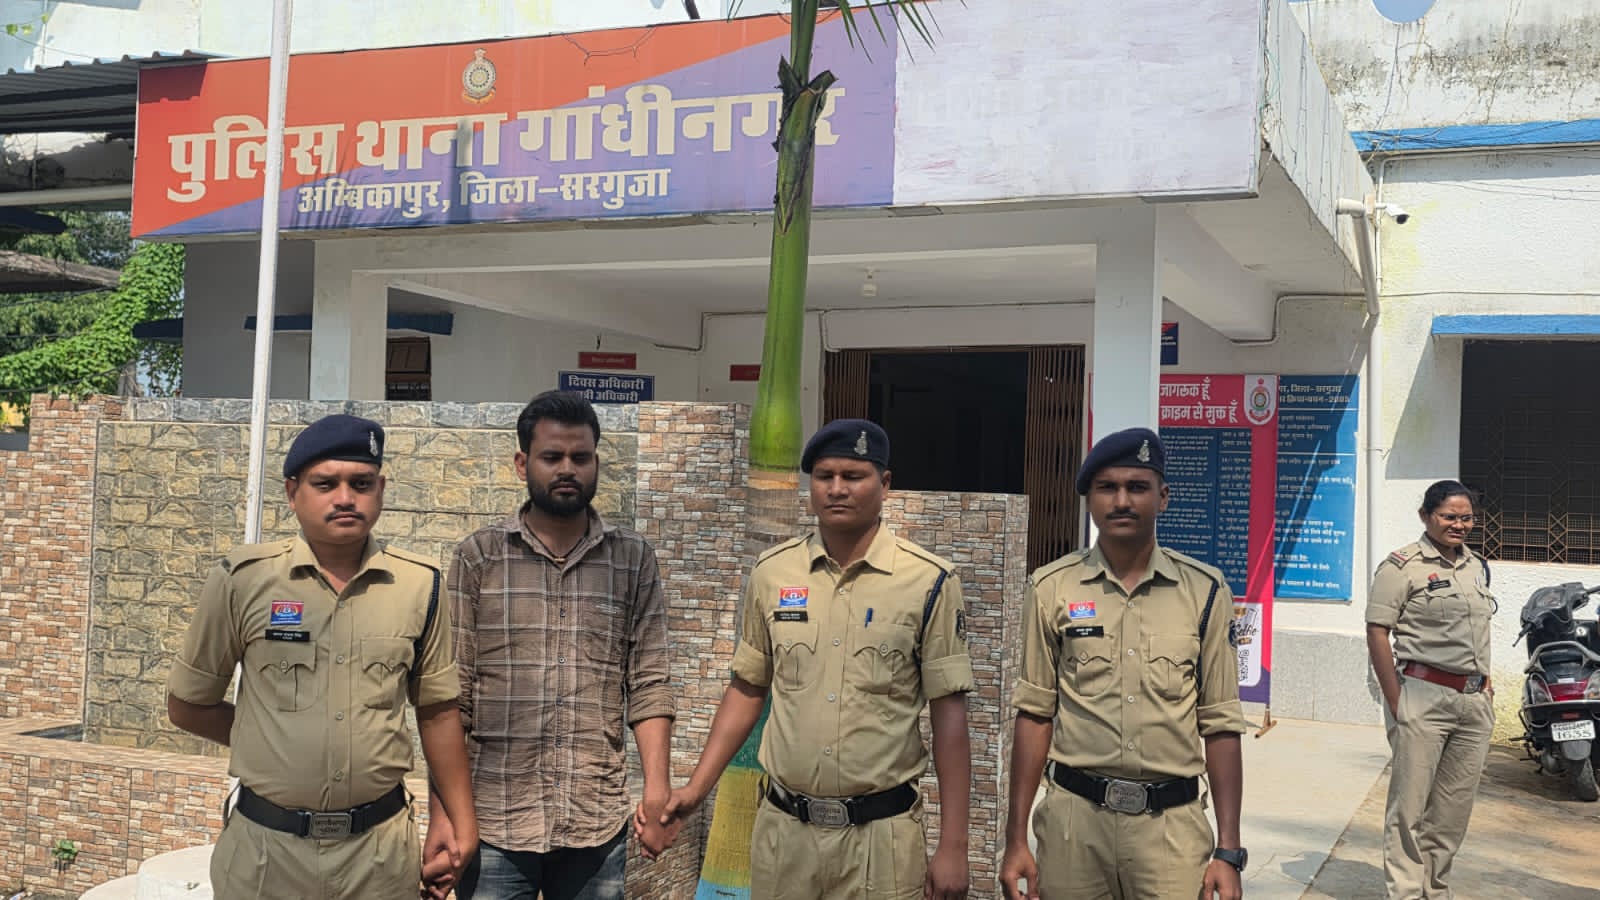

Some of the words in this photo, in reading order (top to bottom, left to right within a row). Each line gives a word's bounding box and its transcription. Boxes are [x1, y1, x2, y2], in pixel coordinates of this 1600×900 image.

[167, 114, 345, 204] पुलिस
[356, 112, 508, 172] थाना
[516, 84, 846, 162] गांधीनगर
[298, 178, 450, 219] अम्बिकापुर,
[598, 376, 644, 391] अधिकारी
[1160, 383, 1200, 398] जागरूक
[596, 390, 638, 402] अधिकारी
[1160, 405, 1191, 421] क्राइम
[1191, 401, 1204, 420] से
[1205, 405, 1227, 425] मुक्त
